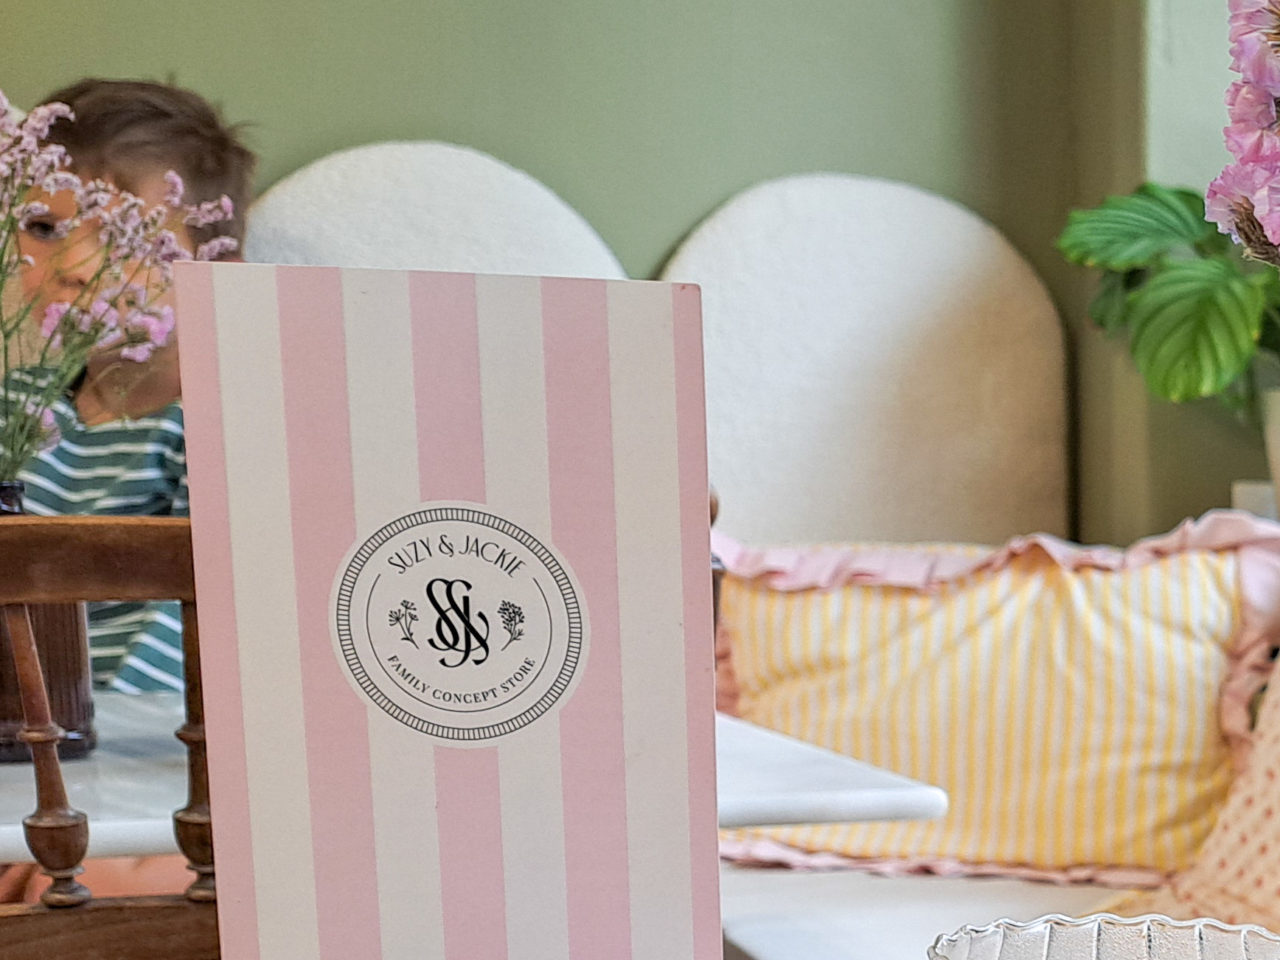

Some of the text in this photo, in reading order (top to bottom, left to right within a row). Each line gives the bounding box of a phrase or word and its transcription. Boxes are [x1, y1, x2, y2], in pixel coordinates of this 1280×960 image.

[387, 534, 527, 578] SUZY & JACKIE
[386, 654, 536, 704] FAMILY CONCEPT STORE
